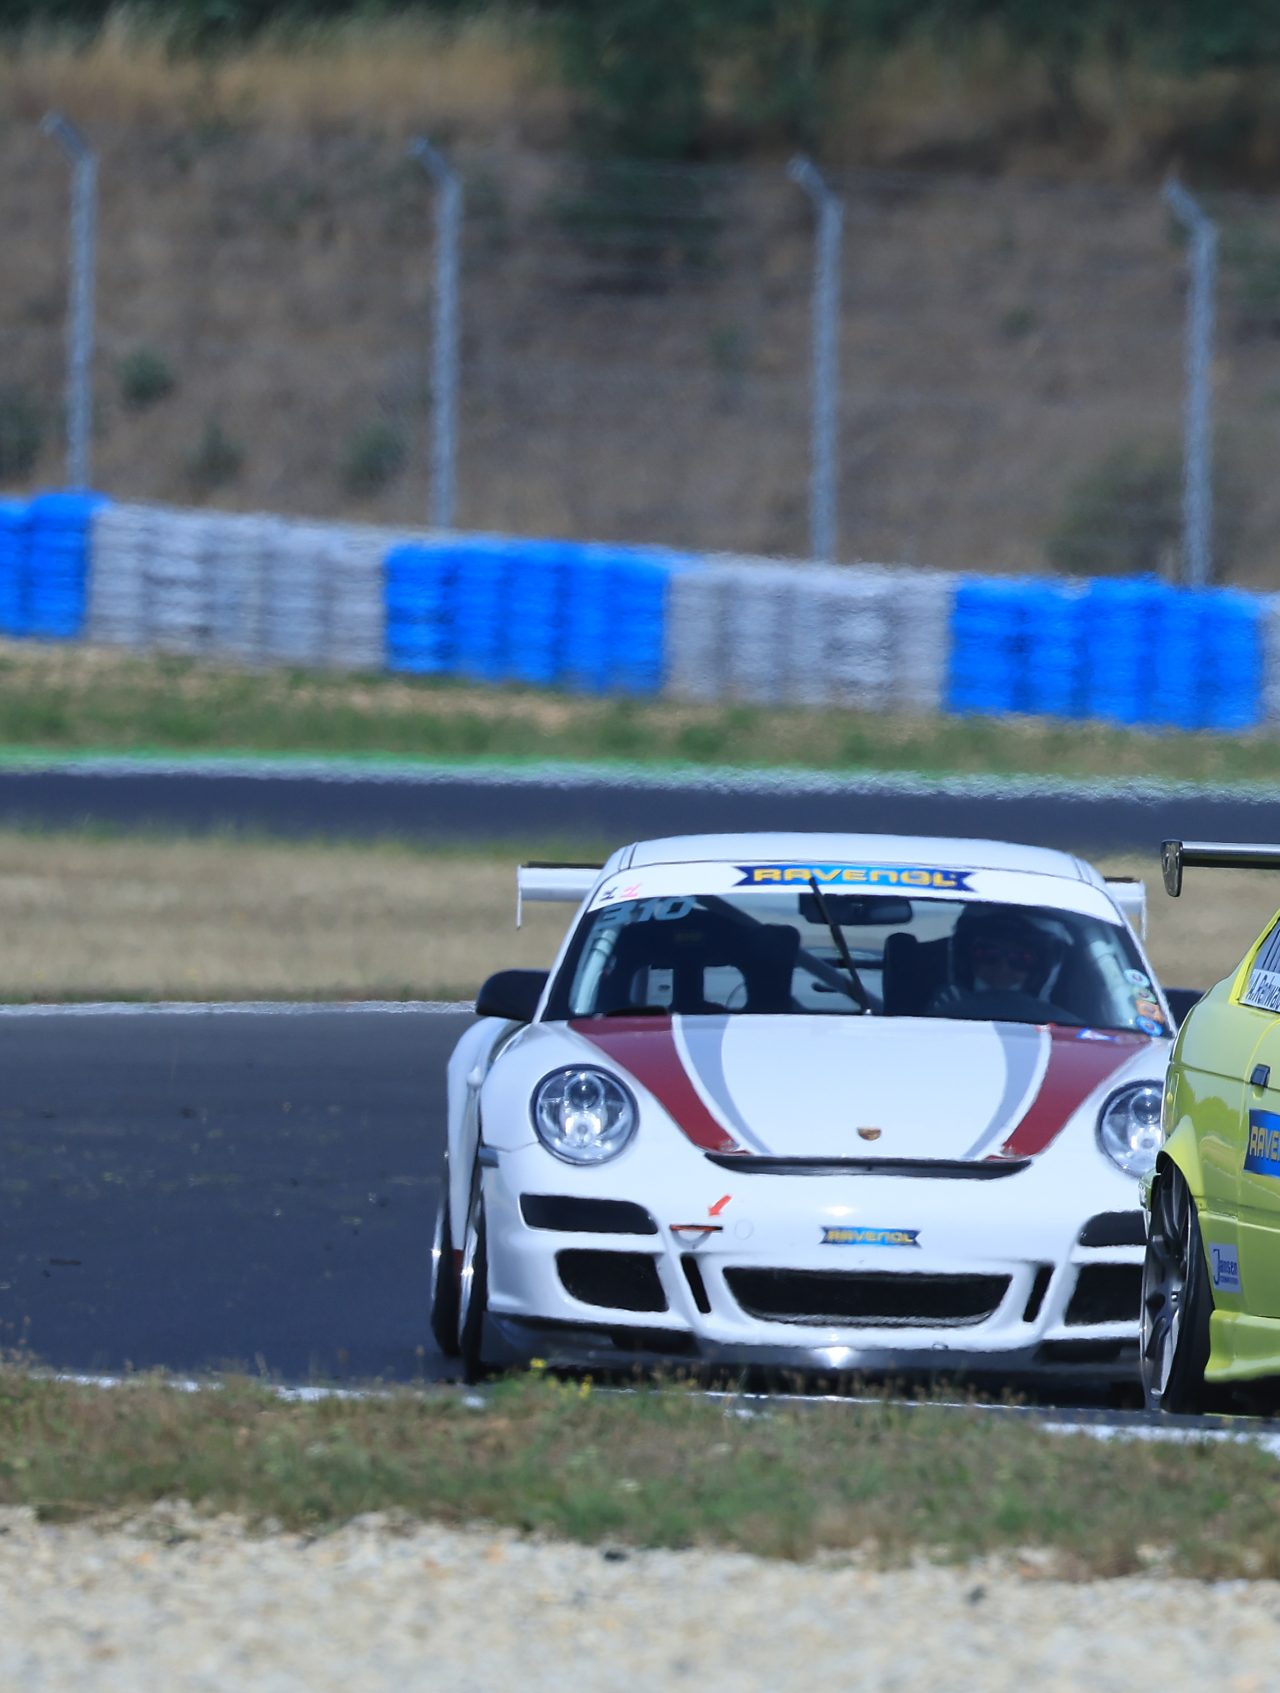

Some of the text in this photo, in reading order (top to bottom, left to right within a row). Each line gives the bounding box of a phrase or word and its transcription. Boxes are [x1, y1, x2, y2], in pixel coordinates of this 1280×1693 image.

[754, 868, 958, 887] RAVENOL
[592, 896, 697, 928] 310
[828, 1230, 913, 1243] RAVENOL
